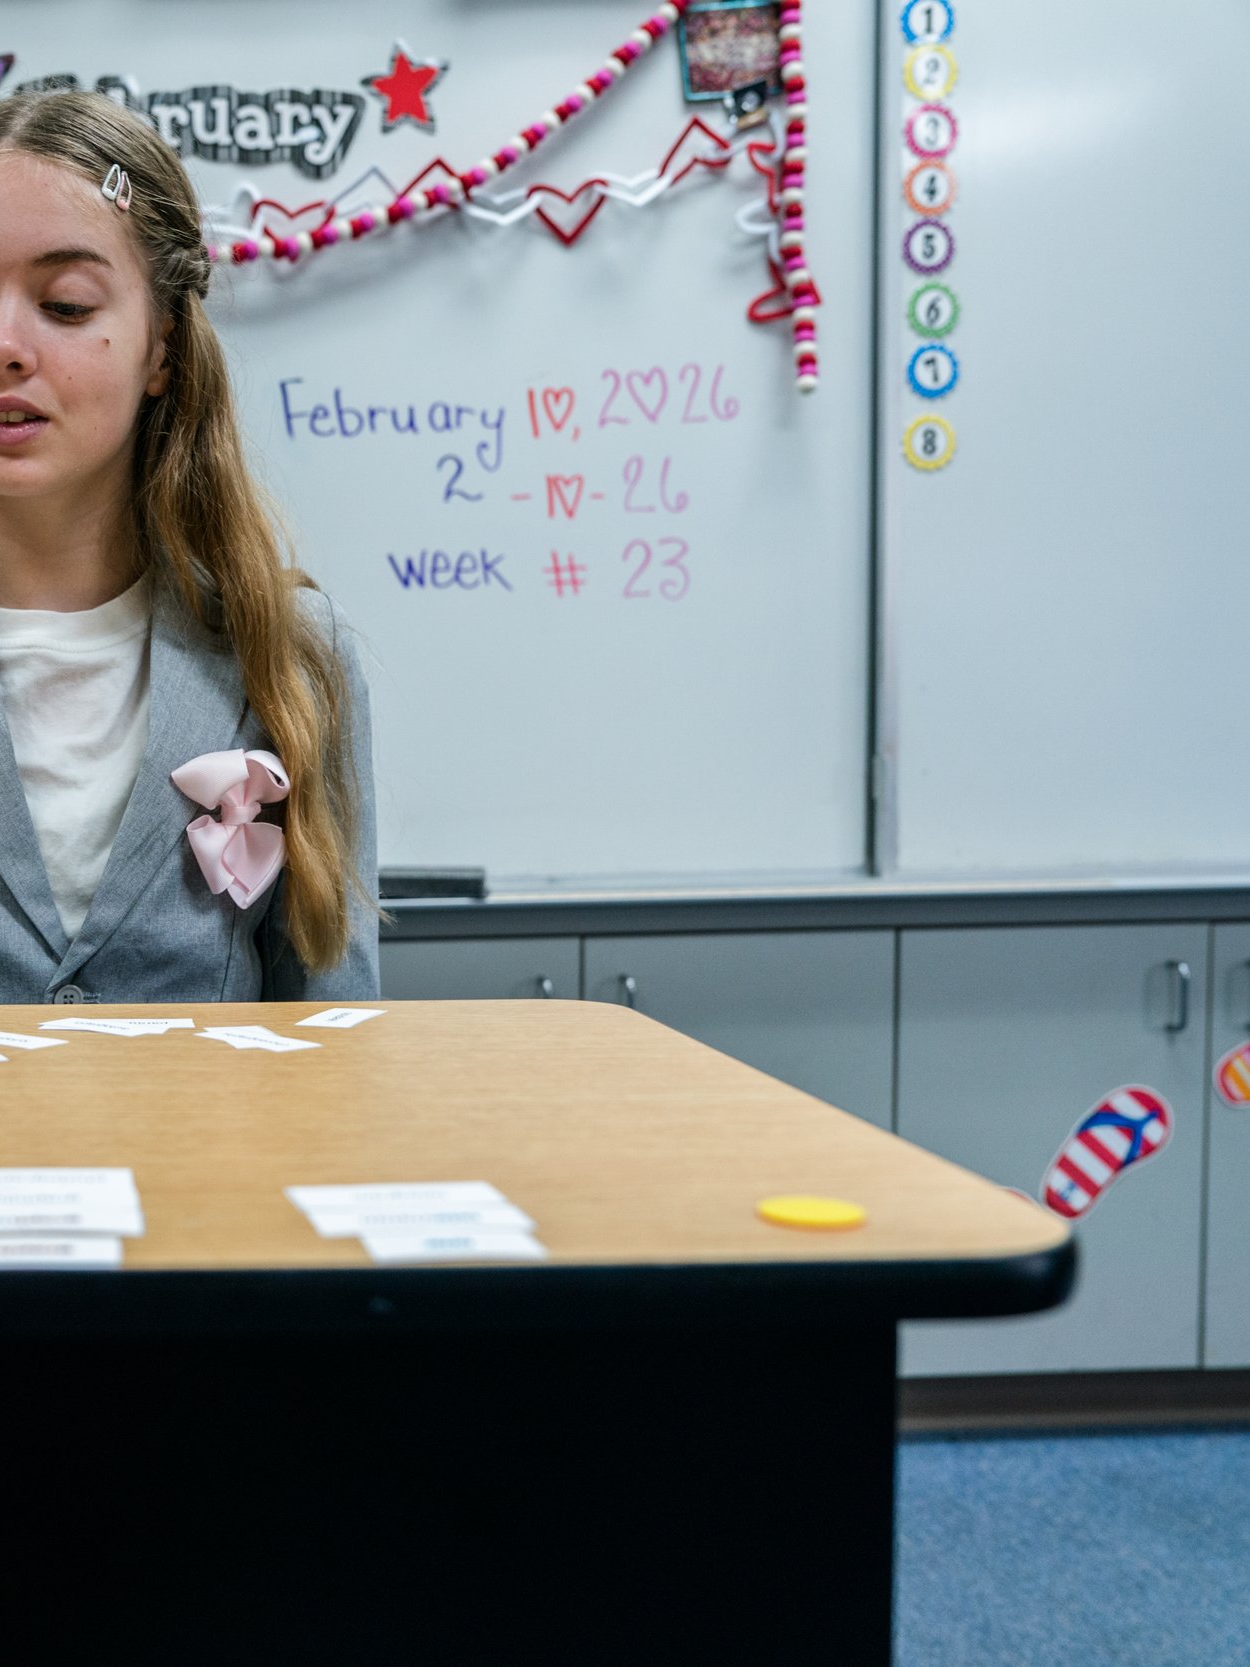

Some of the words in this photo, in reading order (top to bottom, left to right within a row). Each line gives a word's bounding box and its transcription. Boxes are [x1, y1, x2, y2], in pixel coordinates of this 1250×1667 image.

[922, 7, 933, 35] 1
[923, 57, 940, 86] 2
[924, 116, 939, 147] 3
[923, 174, 938, 203] 4
[922, 233, 936, 260] 5
[926, 295, 941, 328] 6
[923, 356, 940, 384] 7
[279, 377, 506, 472] February
[922, 427, 937, 456] 8
[620, 536, 691, 601] 23
